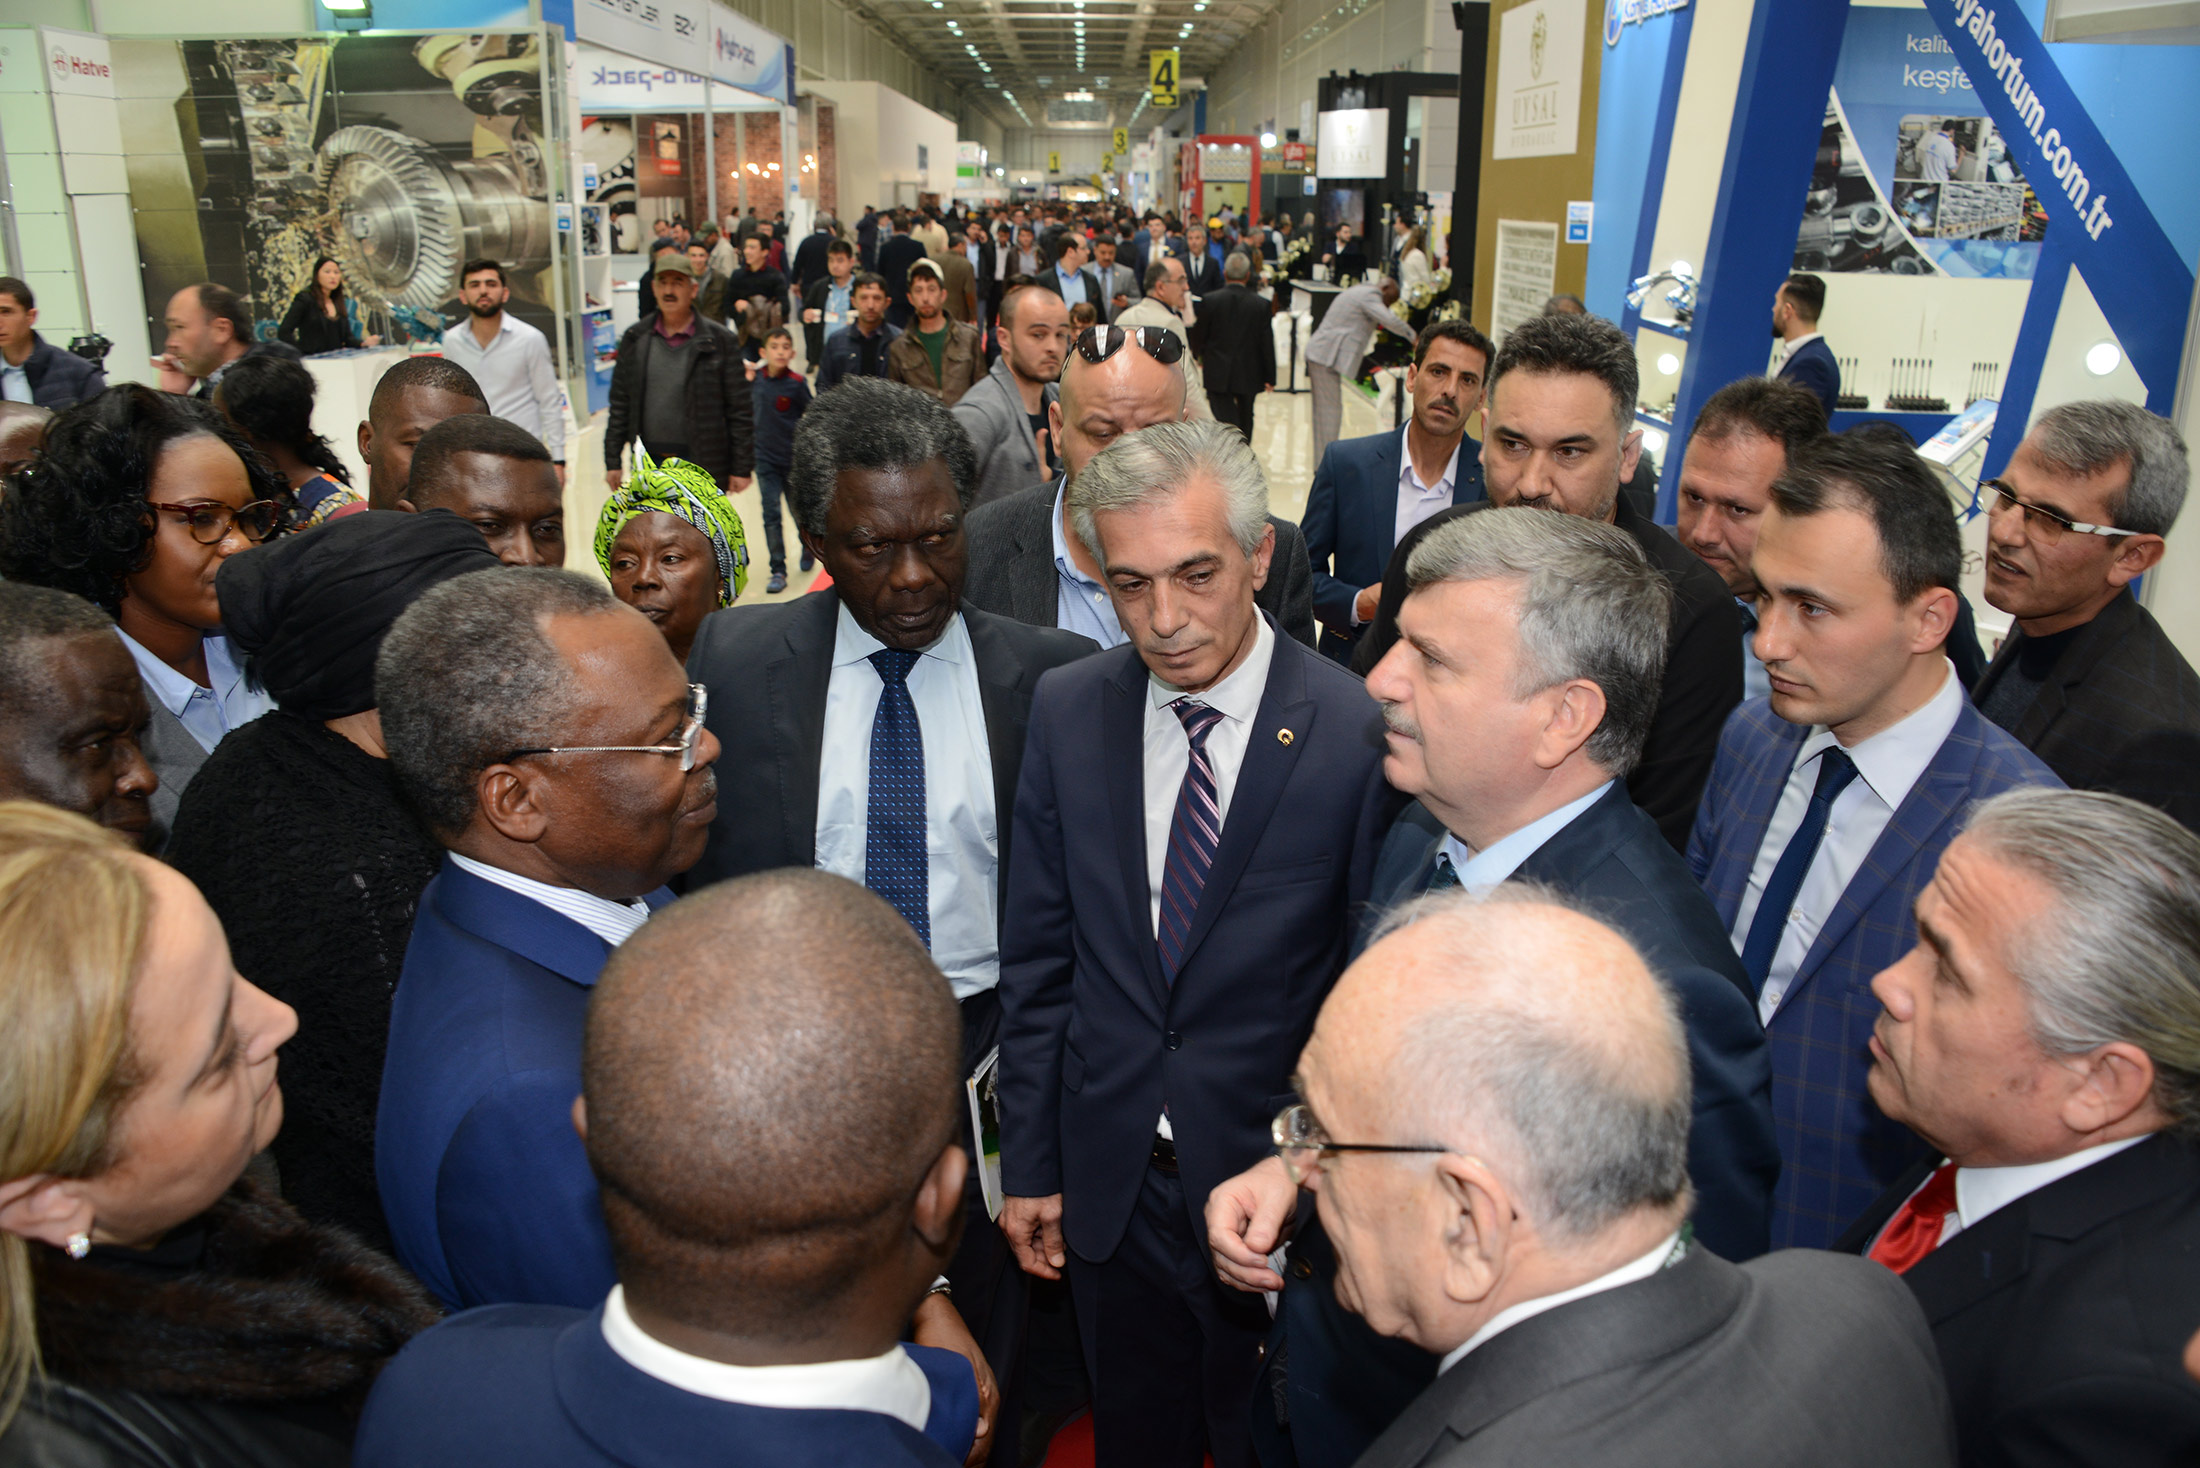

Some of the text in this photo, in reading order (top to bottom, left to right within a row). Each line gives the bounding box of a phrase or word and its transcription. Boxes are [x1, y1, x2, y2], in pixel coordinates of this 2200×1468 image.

[1906, 33, 1954, 54] kalit
[70, 55, 110, 78] Hatve
[1154, 59, 1175, 93] 4
[1513, 90, 1558, 124] UYSAL
[1954, 0, 2113, 241] yahortum.com.tr
[1115, 132, 1125, 149] 3
